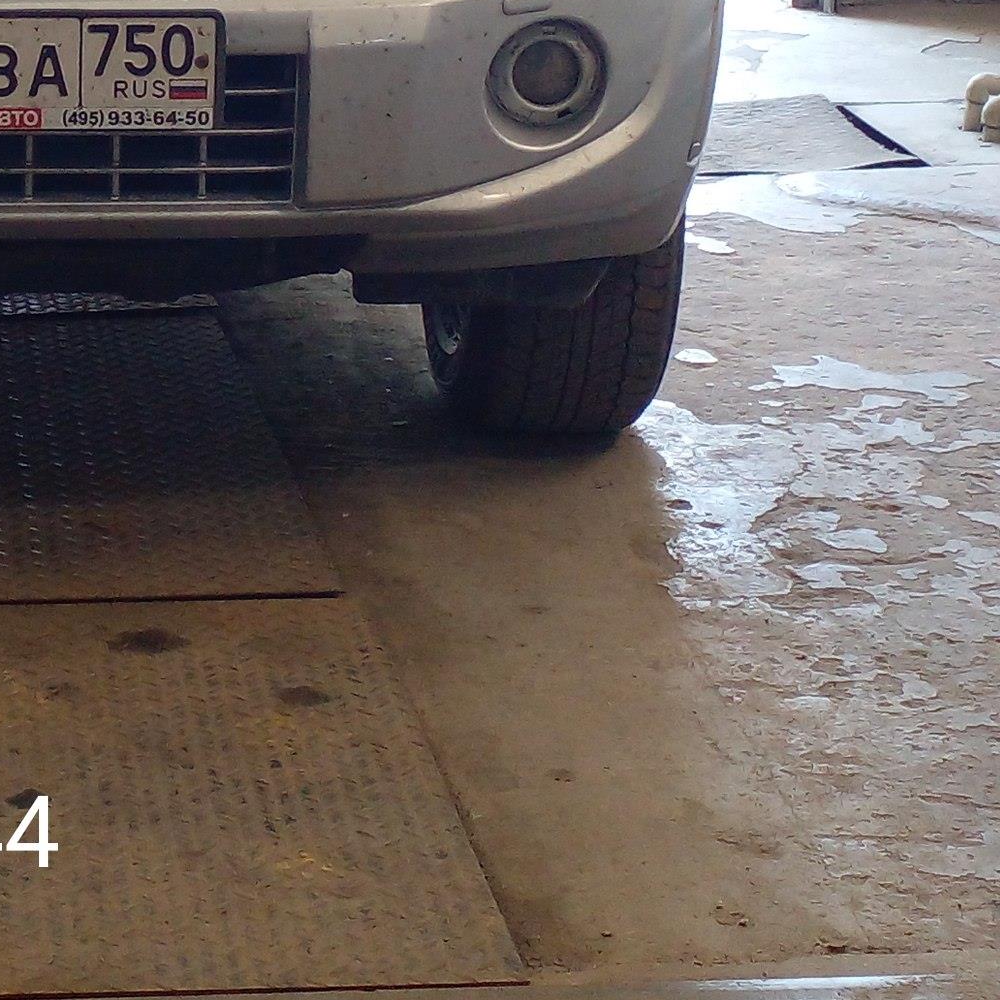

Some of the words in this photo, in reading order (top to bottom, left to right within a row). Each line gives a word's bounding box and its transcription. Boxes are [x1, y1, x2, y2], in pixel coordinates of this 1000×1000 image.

[87, 22, 196, 78] 750
[114, 79, 167, 99] RUS
[62, 109, 105, 127] (495)
[108, 110, 210, 126] 933-64-50
